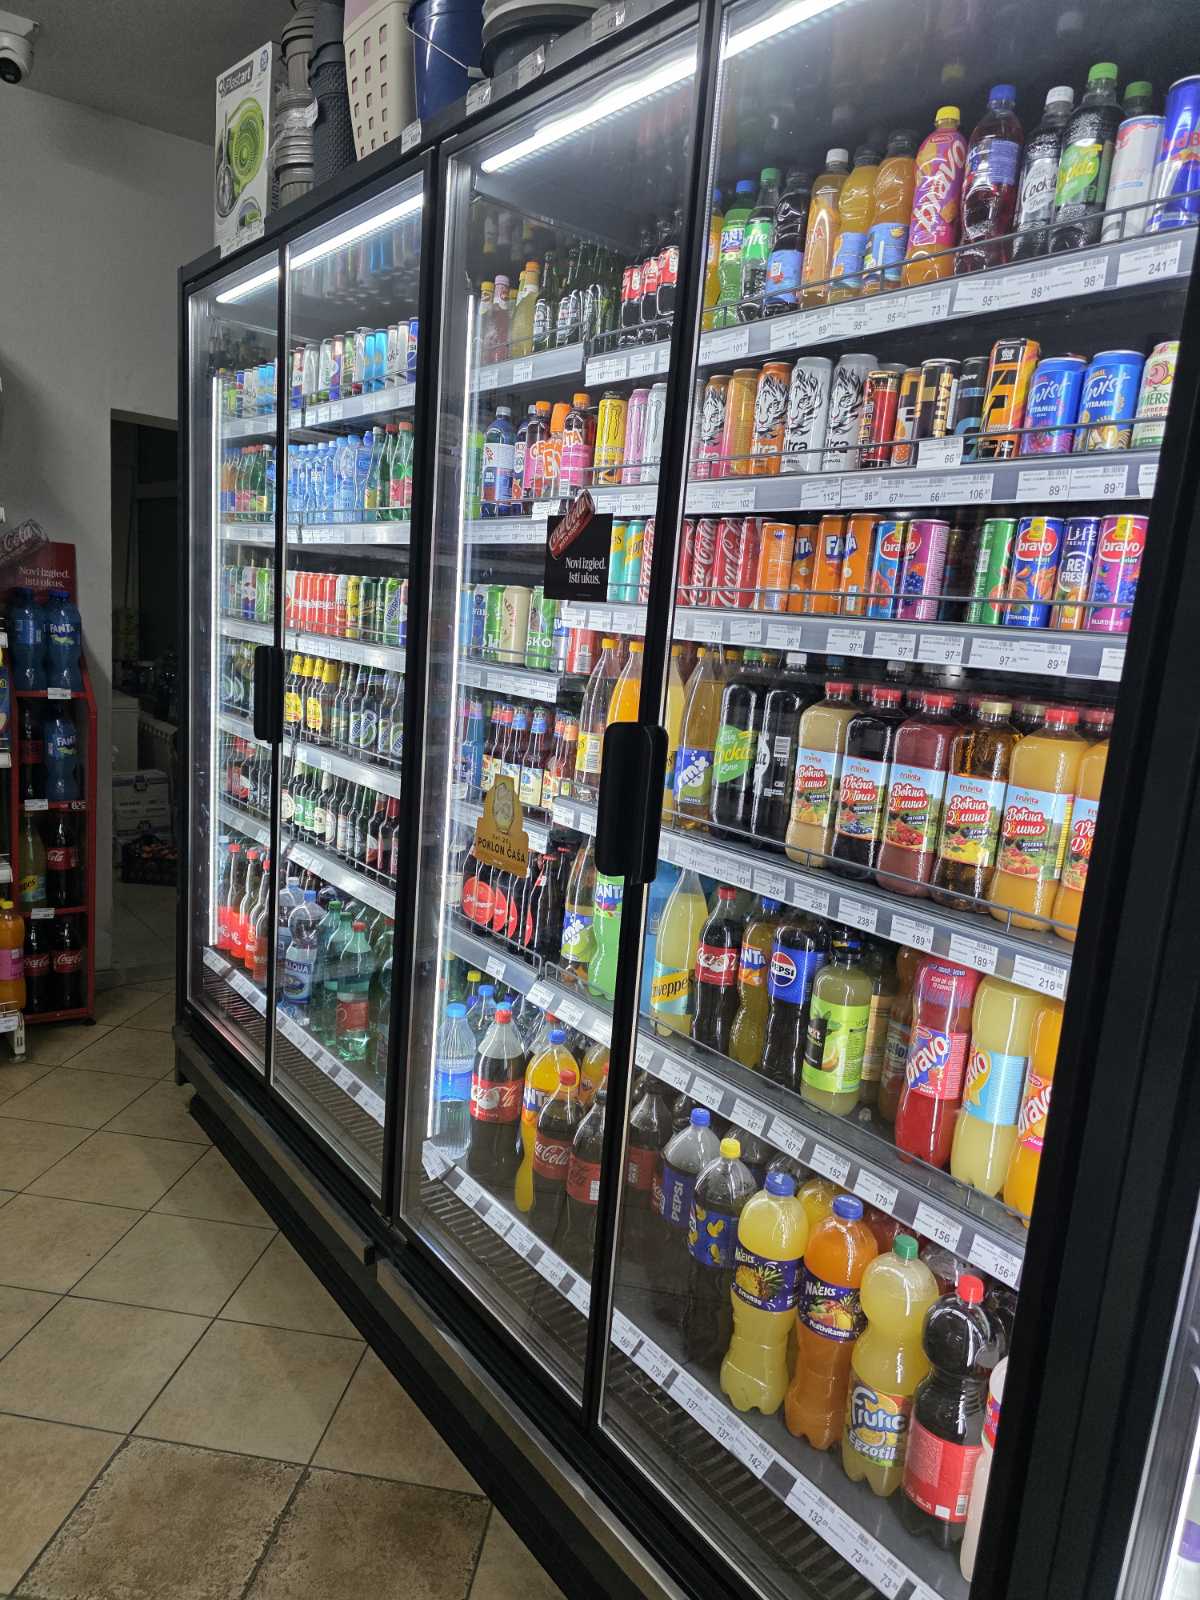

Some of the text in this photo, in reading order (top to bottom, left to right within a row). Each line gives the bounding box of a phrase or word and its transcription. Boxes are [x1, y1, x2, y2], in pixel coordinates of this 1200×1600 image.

[1148, 261, 1167, 275] 241
[1084, 276, 1095, 288] 98
[1028, 381, 1071, 405] Twist
[1084, 373, 1131, 400] Twist
[1103, 483, 1116, 494] 89
[1018, 541, 1052, 552] bravo
[1103, 541, 1140, 552] bravo
[565, 557, 606, 571] Novi izgled.
[580, 573, 600, 584] ukus.
[477, 836, 526, 864] POKLON ČAŠA
[912, 935, 925, 946] 189
[743, 949, 766, 965] NTA
[973, 956, 987, 967] 189
[829, 1166, 841, 1178] 152
[671, 1181, 685, 1222] PEPSI
[934, 1227, 950, 1244] 156
[993, 1263, 1008, 1278] 156
[717, 1426, 729, 1440] 137
[807, 1509, 822, 1525] 132
[853, 1549, 863, 1563] 73
[880, 1573, 892, 1588] 73
